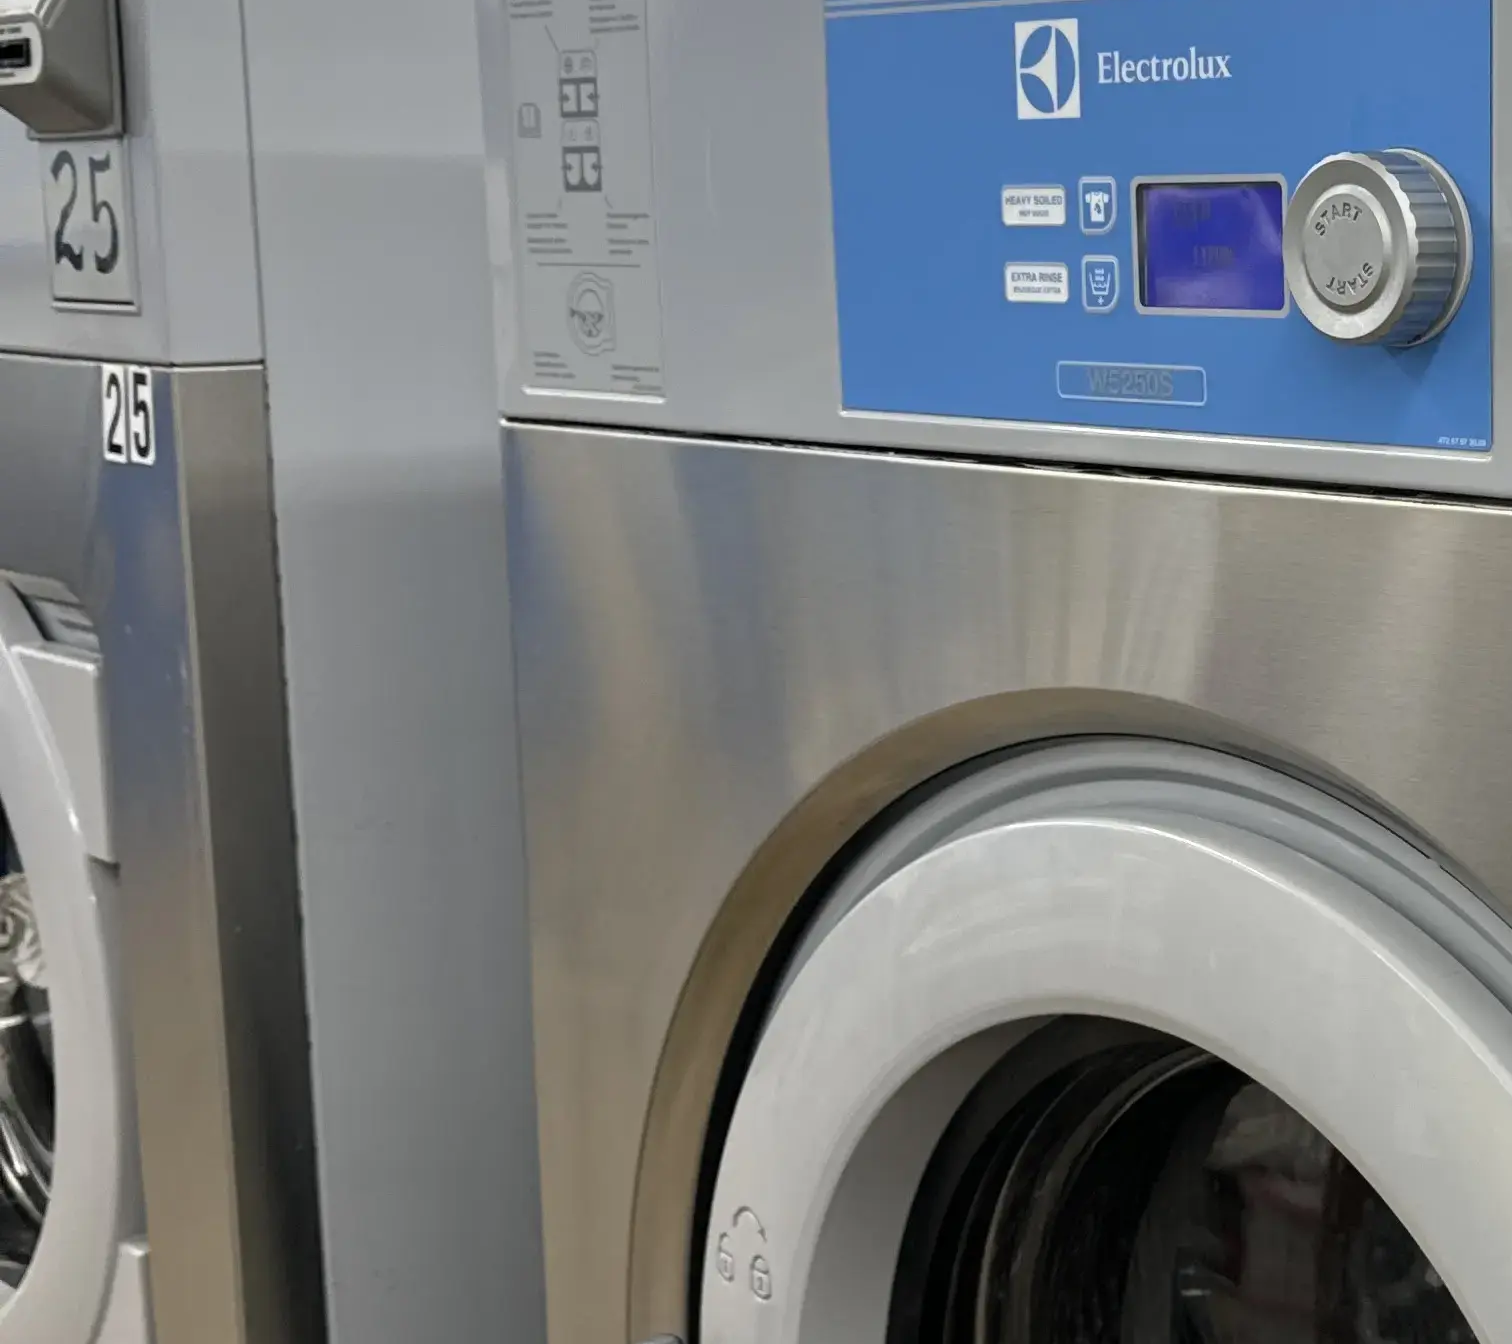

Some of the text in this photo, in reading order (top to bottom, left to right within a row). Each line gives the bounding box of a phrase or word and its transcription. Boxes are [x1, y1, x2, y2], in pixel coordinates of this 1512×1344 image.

[1097, 46, 1232, 84] Electrolux
[52, 149, 119, 274] 25
[1005, 195, 1063, 205] HEAVY SOILED
[1315, 202, 1362, 236] START
[1011, 272, 1063, 283] EXTRA RINSE
[1326, 262, 1373, 295] START
[1086, 367, 1174, 397] W5250S
[106, 372, 151, 457] 25
